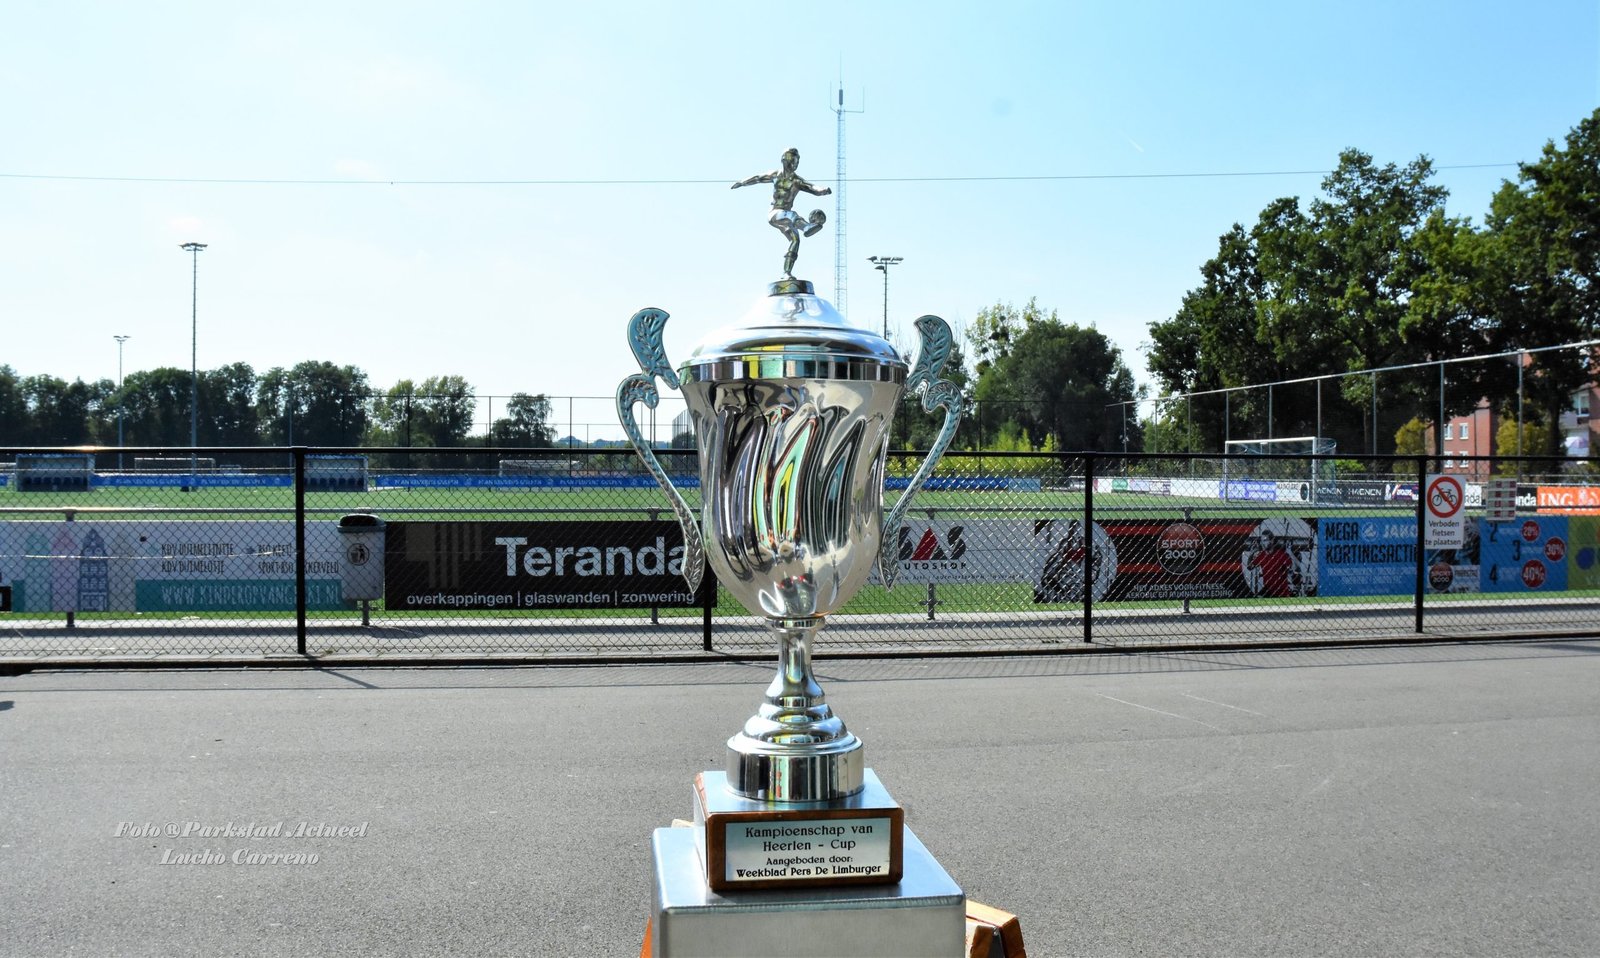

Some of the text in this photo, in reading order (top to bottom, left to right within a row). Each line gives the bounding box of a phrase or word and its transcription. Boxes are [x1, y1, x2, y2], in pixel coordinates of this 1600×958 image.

[1540, 492, 1573, 510] ING
[1325, 522, 1359, 540] MEGA
[1162, 540, 1200, 548] SPORT
[495, 536, 685, 576] Teranda
[1165, 550, 1196, 558] 2000
[1523, 566, 1544, 581] 40%
[407, 591, 695, 606] overkappingen glaswanden zonwering
[746, 825, 872, 838] Kampioenschap van
[764, 840, 812, 851] Heerlen
[830, 840, 856, 850] Cup
[766, 856, 825, 866] Aangeboden
[736, 864, 881, 878] Weekblad Pers De Limburger
